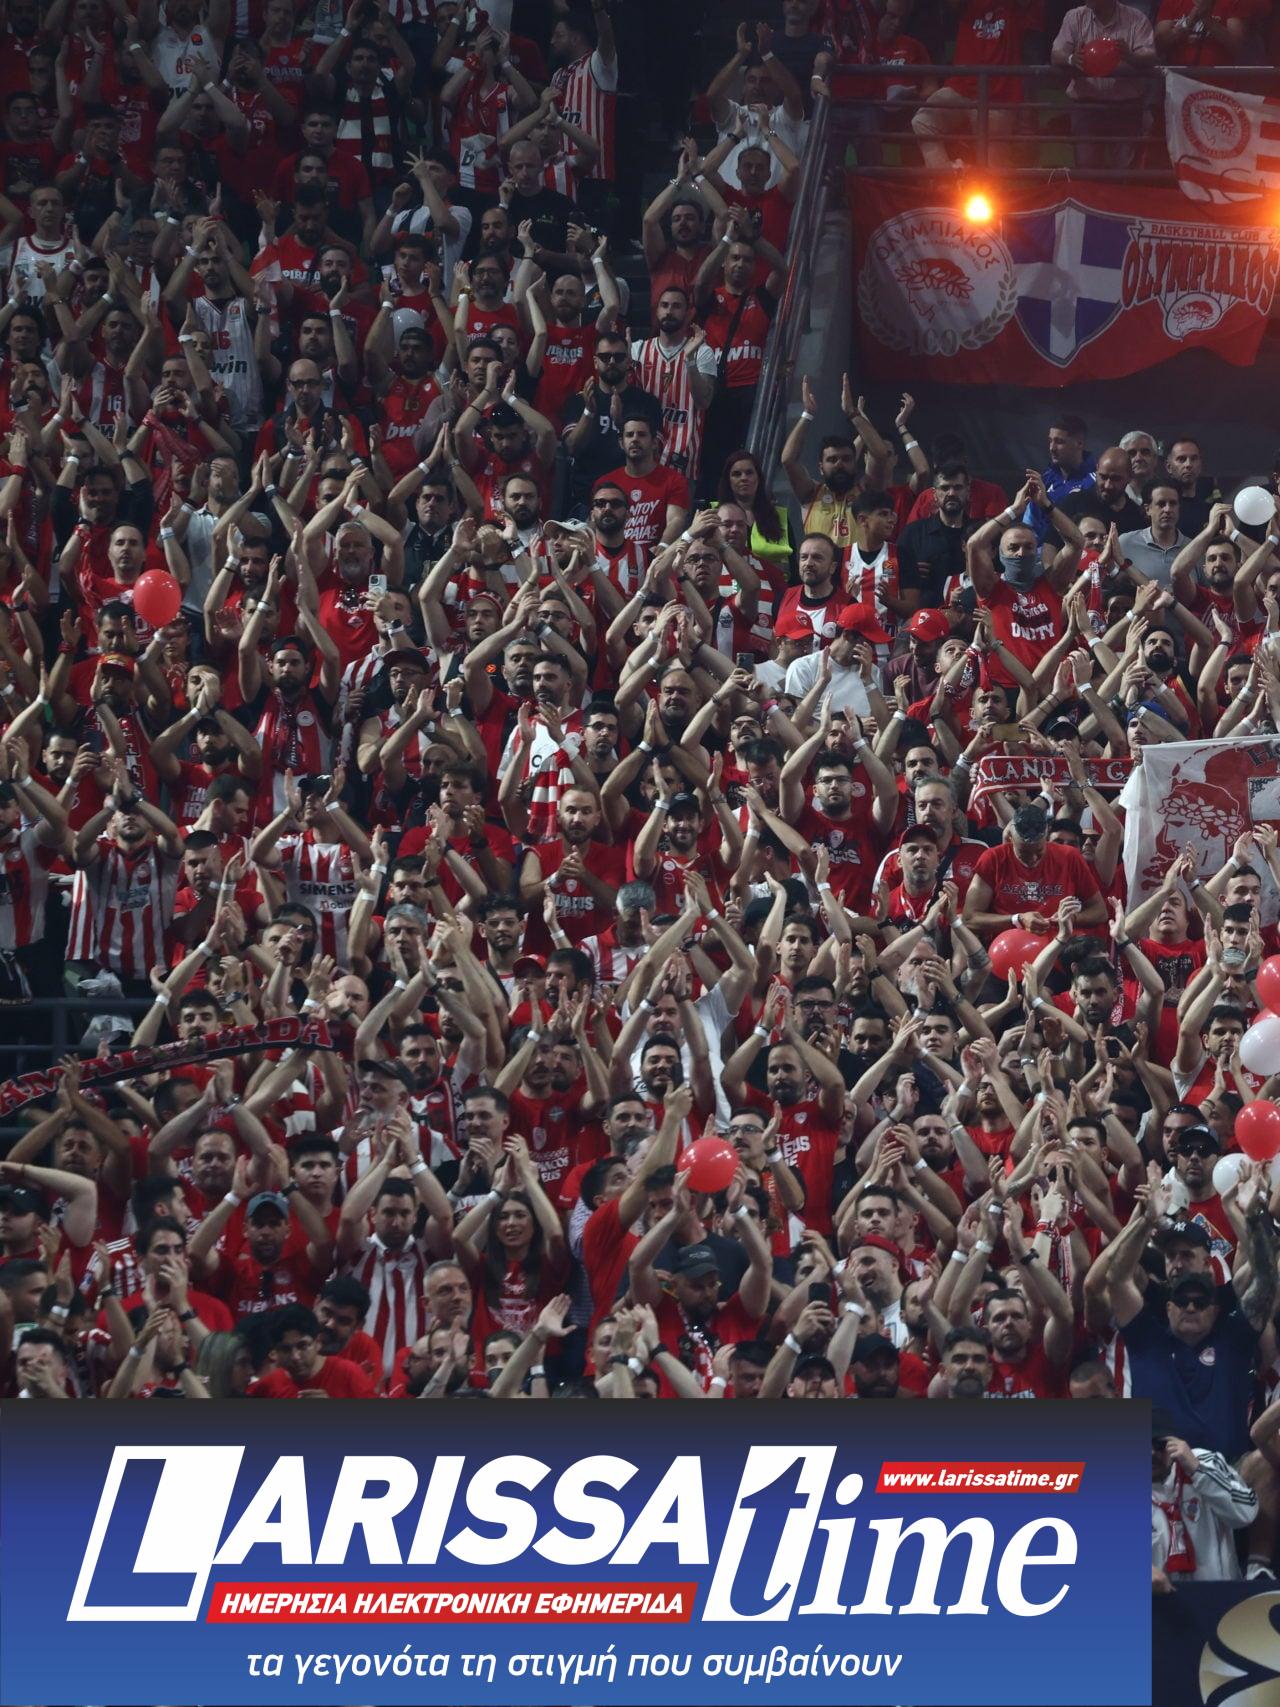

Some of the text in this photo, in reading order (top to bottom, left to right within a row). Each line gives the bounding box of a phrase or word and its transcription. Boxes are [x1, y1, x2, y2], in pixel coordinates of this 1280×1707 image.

[1149, 224, 1260, 242] BASKETBALL CLUB
[876, 219, 1000, 270] ΟΛΥΜΠΙΑΚΟΣ
[210, 355, 246, 374] win
[832, 518, 849, 538] 16
[1011, 622, 1055, 641] UNITY
[991, 757, 1056, 783] LAND
